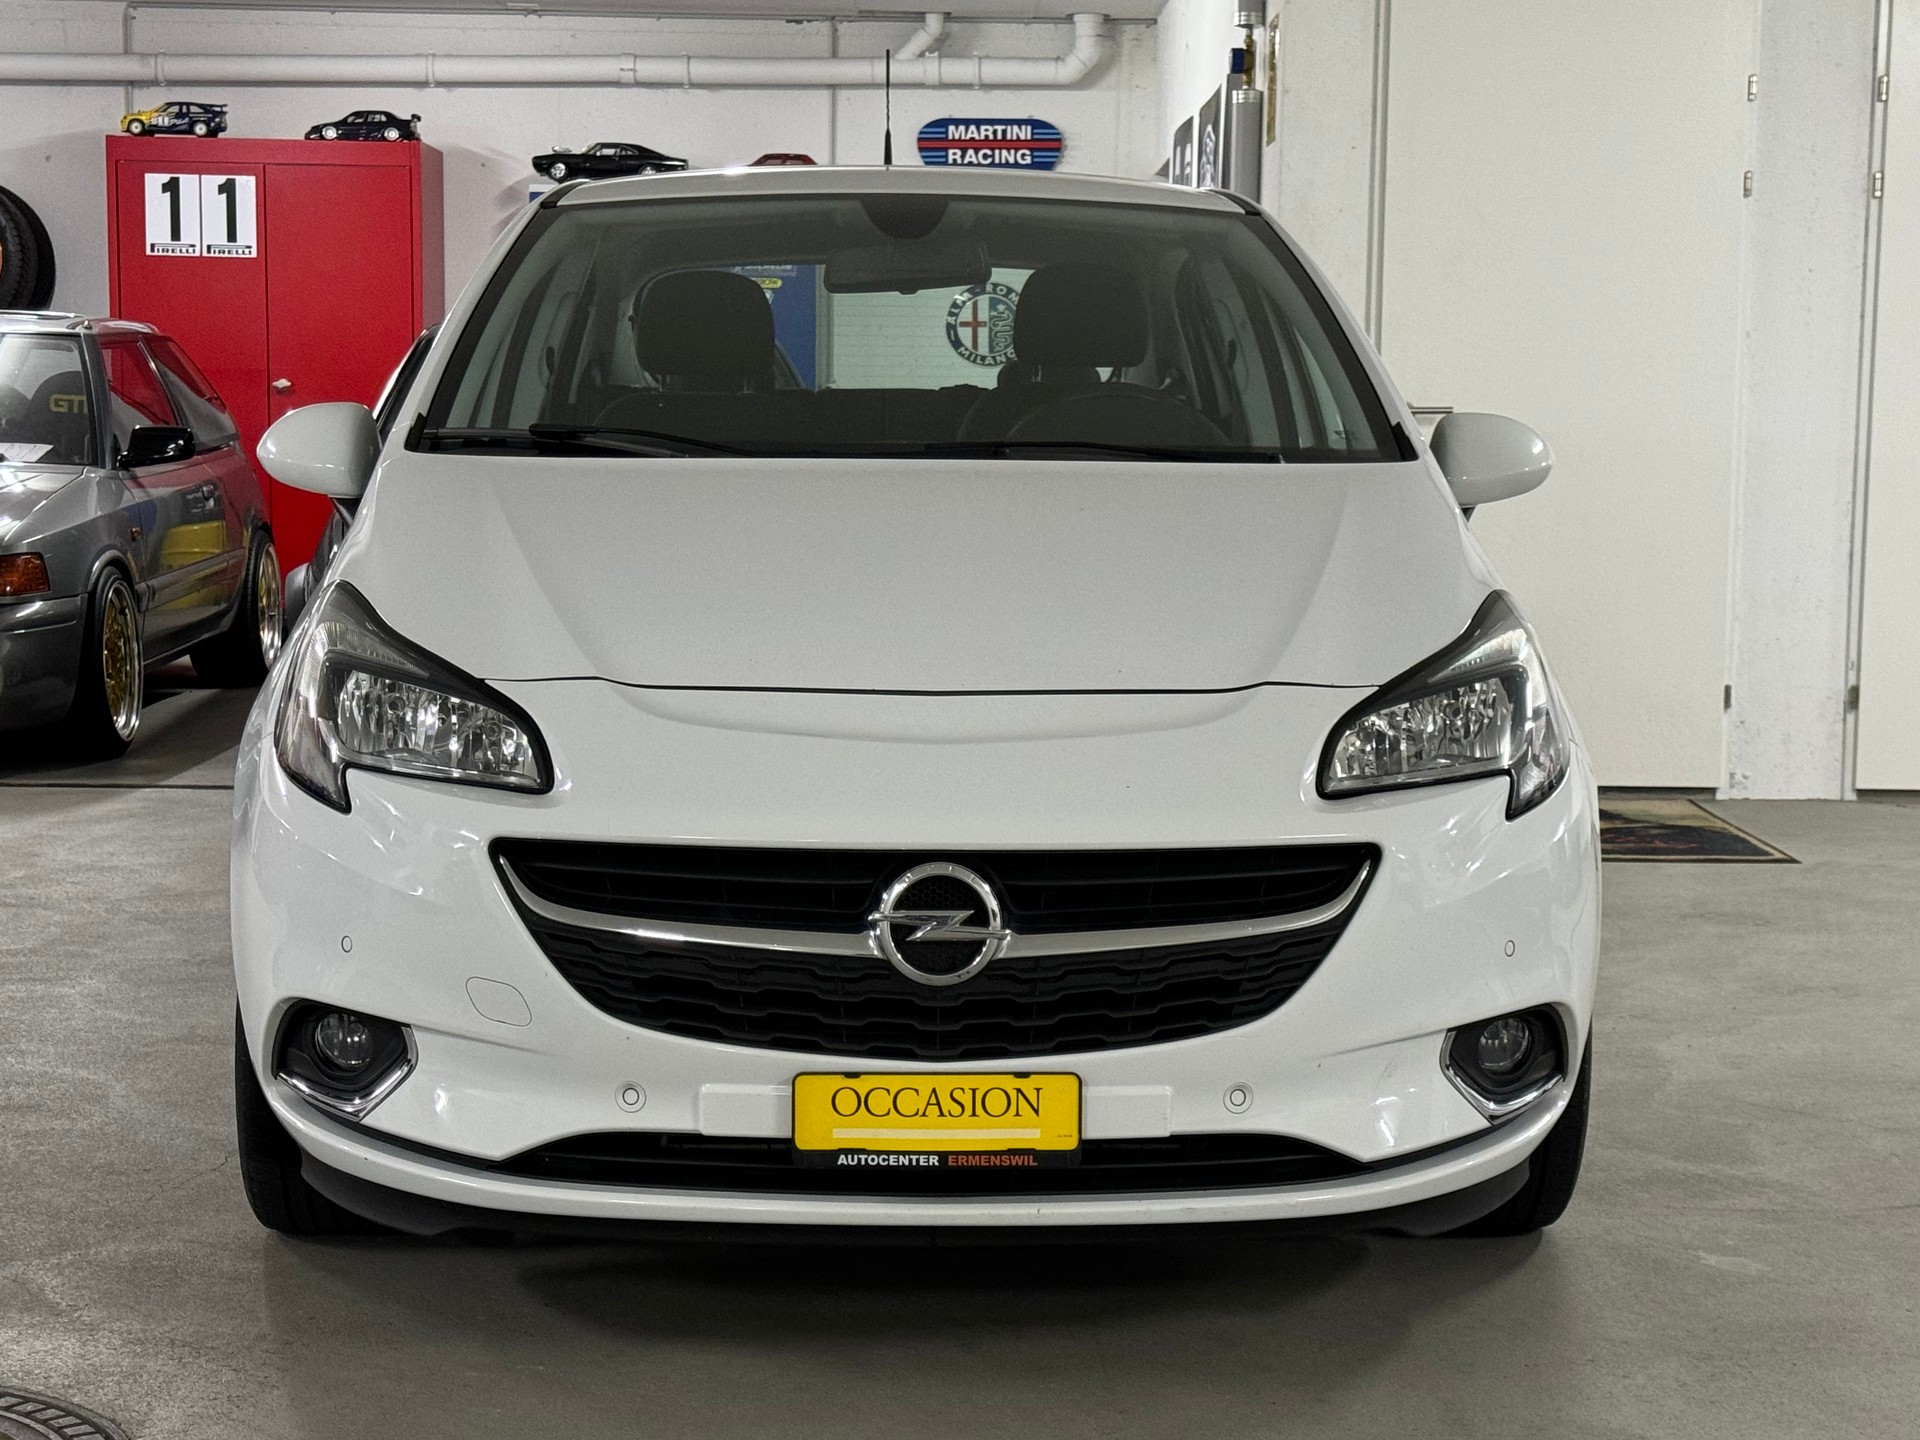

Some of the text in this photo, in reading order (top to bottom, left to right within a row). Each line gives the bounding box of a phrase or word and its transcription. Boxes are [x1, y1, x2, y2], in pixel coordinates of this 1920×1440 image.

[947, 124, 1032, 141] MARTINI
[947, 148, 1032, 165] RACING
[150, 243, 197, 254] PIRELLI
[206, 244, 253, 256] PIRELLI
[831, 1086, 1043, 1118] OCCASION
[837, 1154, 1038, 1166] AUTOCENTER ERMENSWIL
